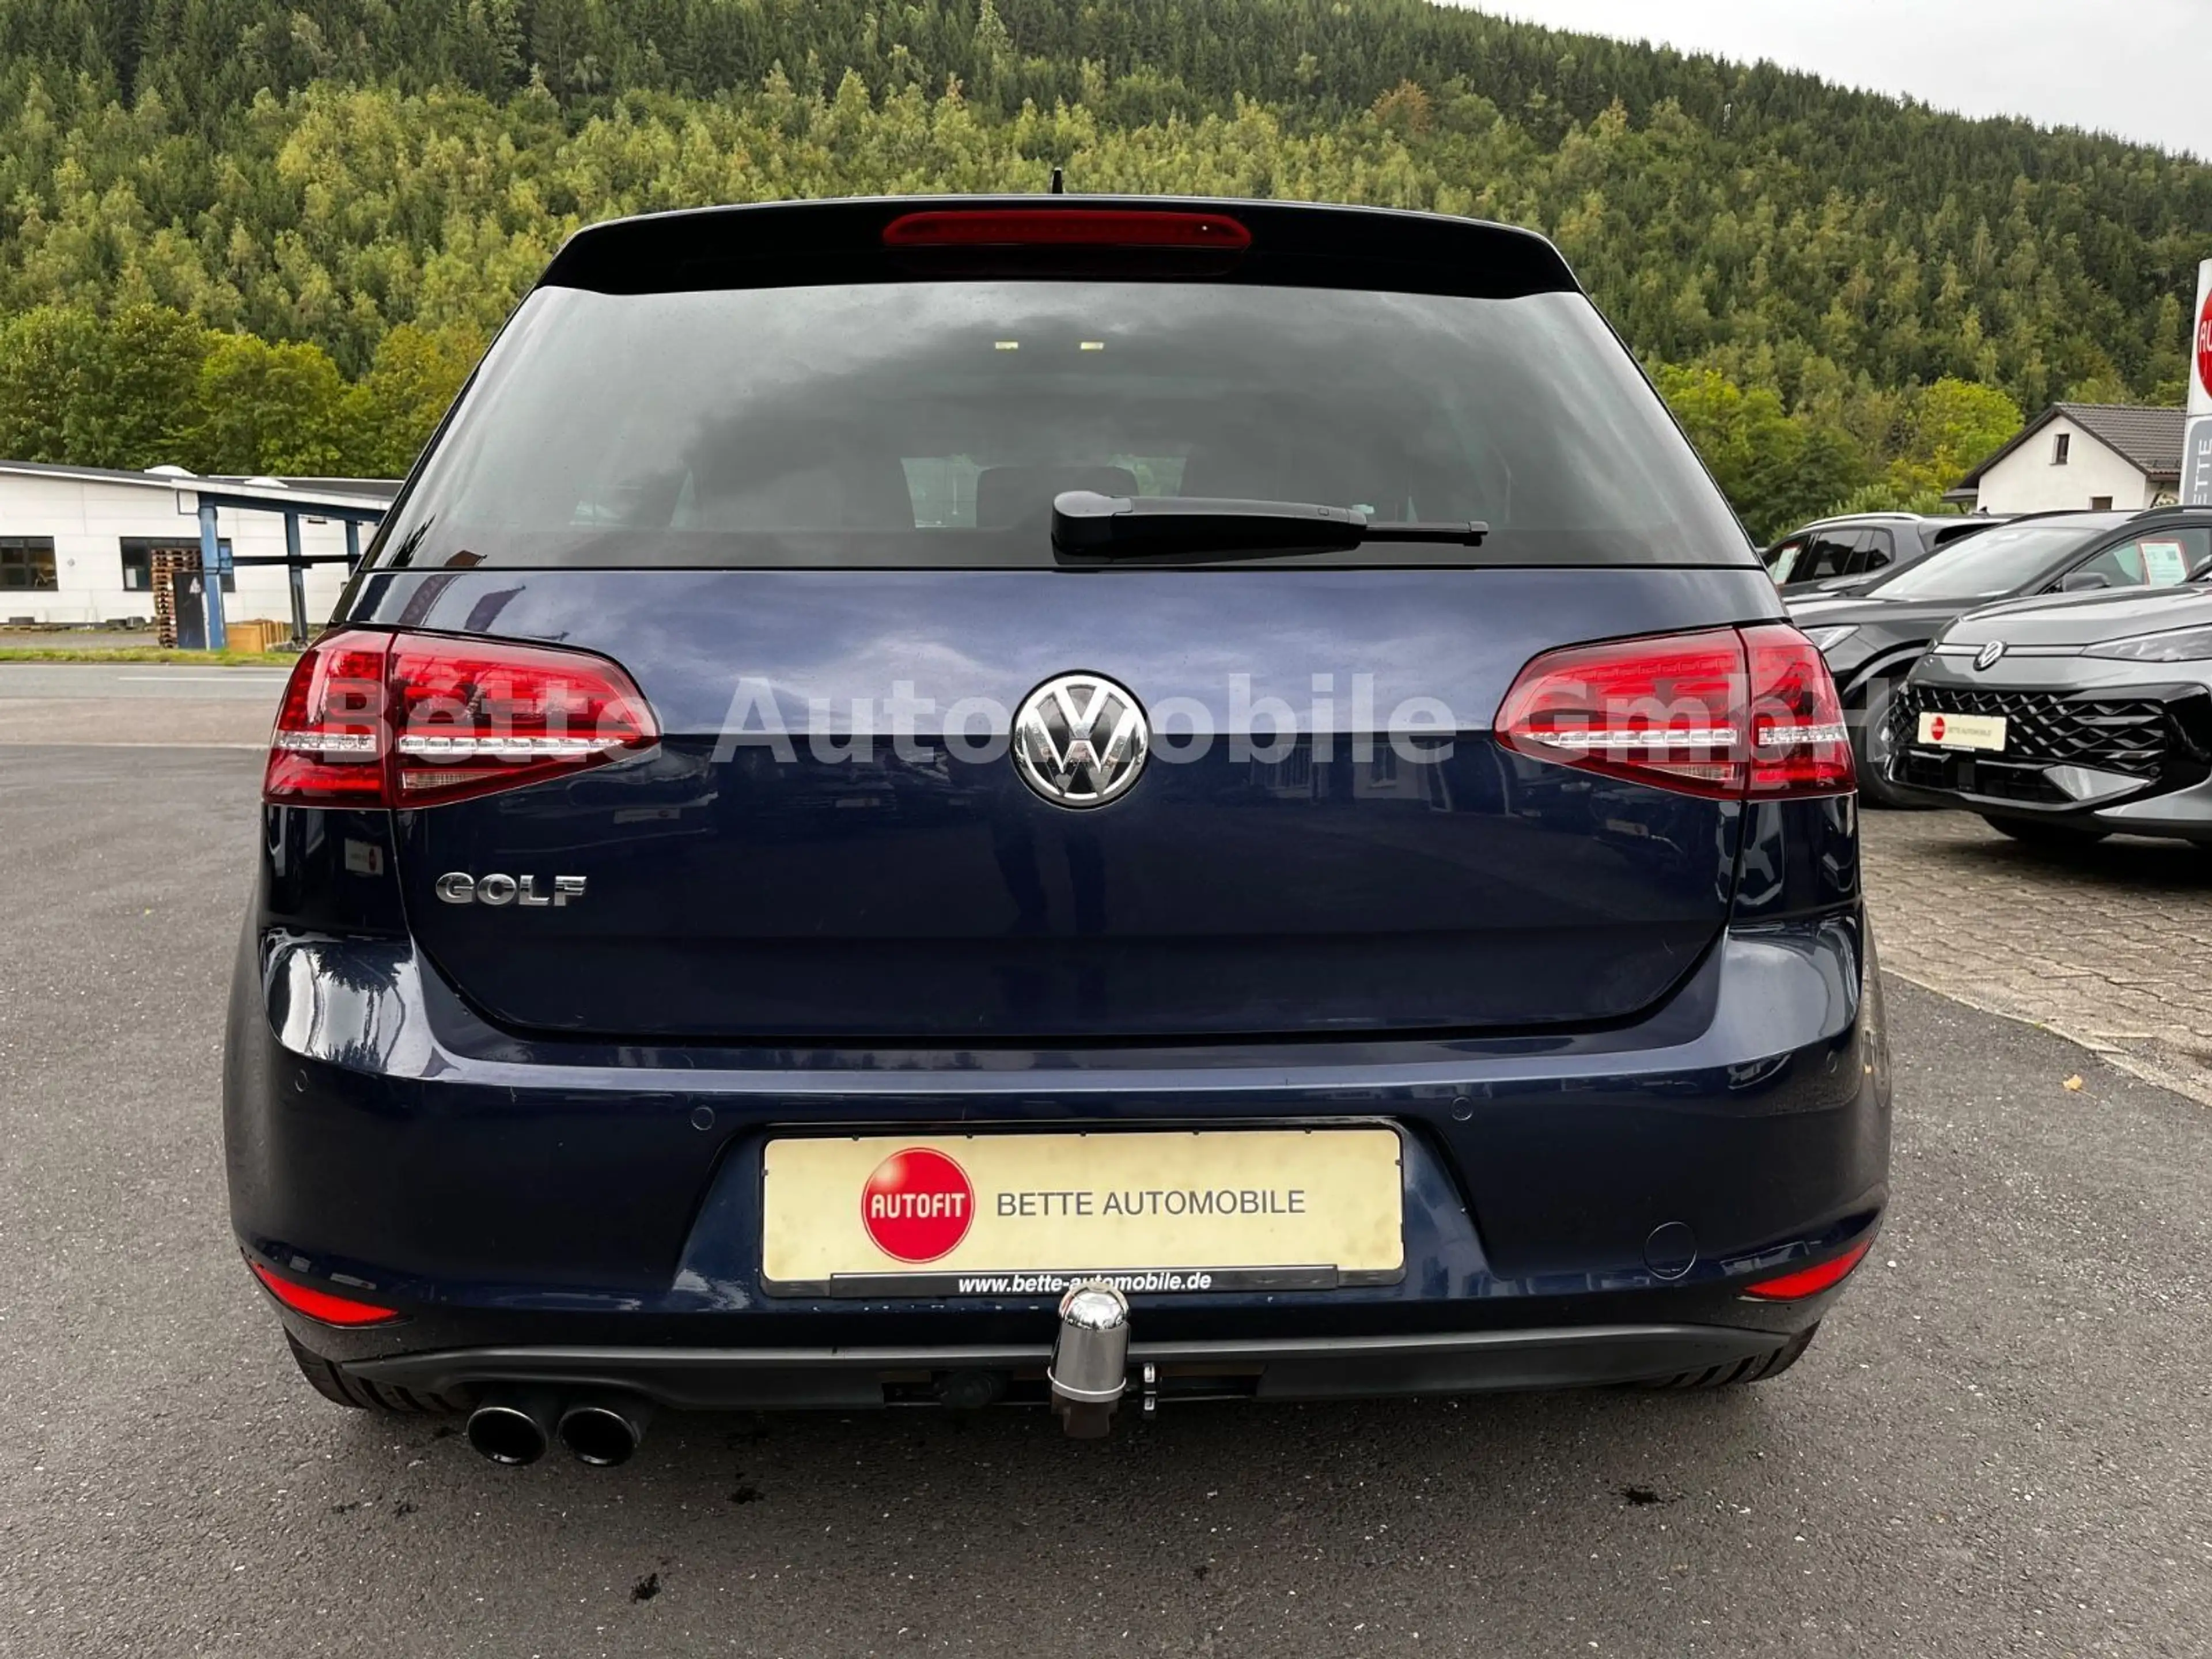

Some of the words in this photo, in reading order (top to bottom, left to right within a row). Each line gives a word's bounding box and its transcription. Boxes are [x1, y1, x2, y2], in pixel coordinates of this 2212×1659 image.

[2199, 319, 2212, 354] AU
[2192, 438, 2212, 505] ETTE
[435, 872, 586, 906] GOLF
[871, 1193, 965, 1218] AUTOFIT
[997, 1192, 1093, 1216] BETTE
[1103, 1190, 1305, 1215] AUTOMOBILE
